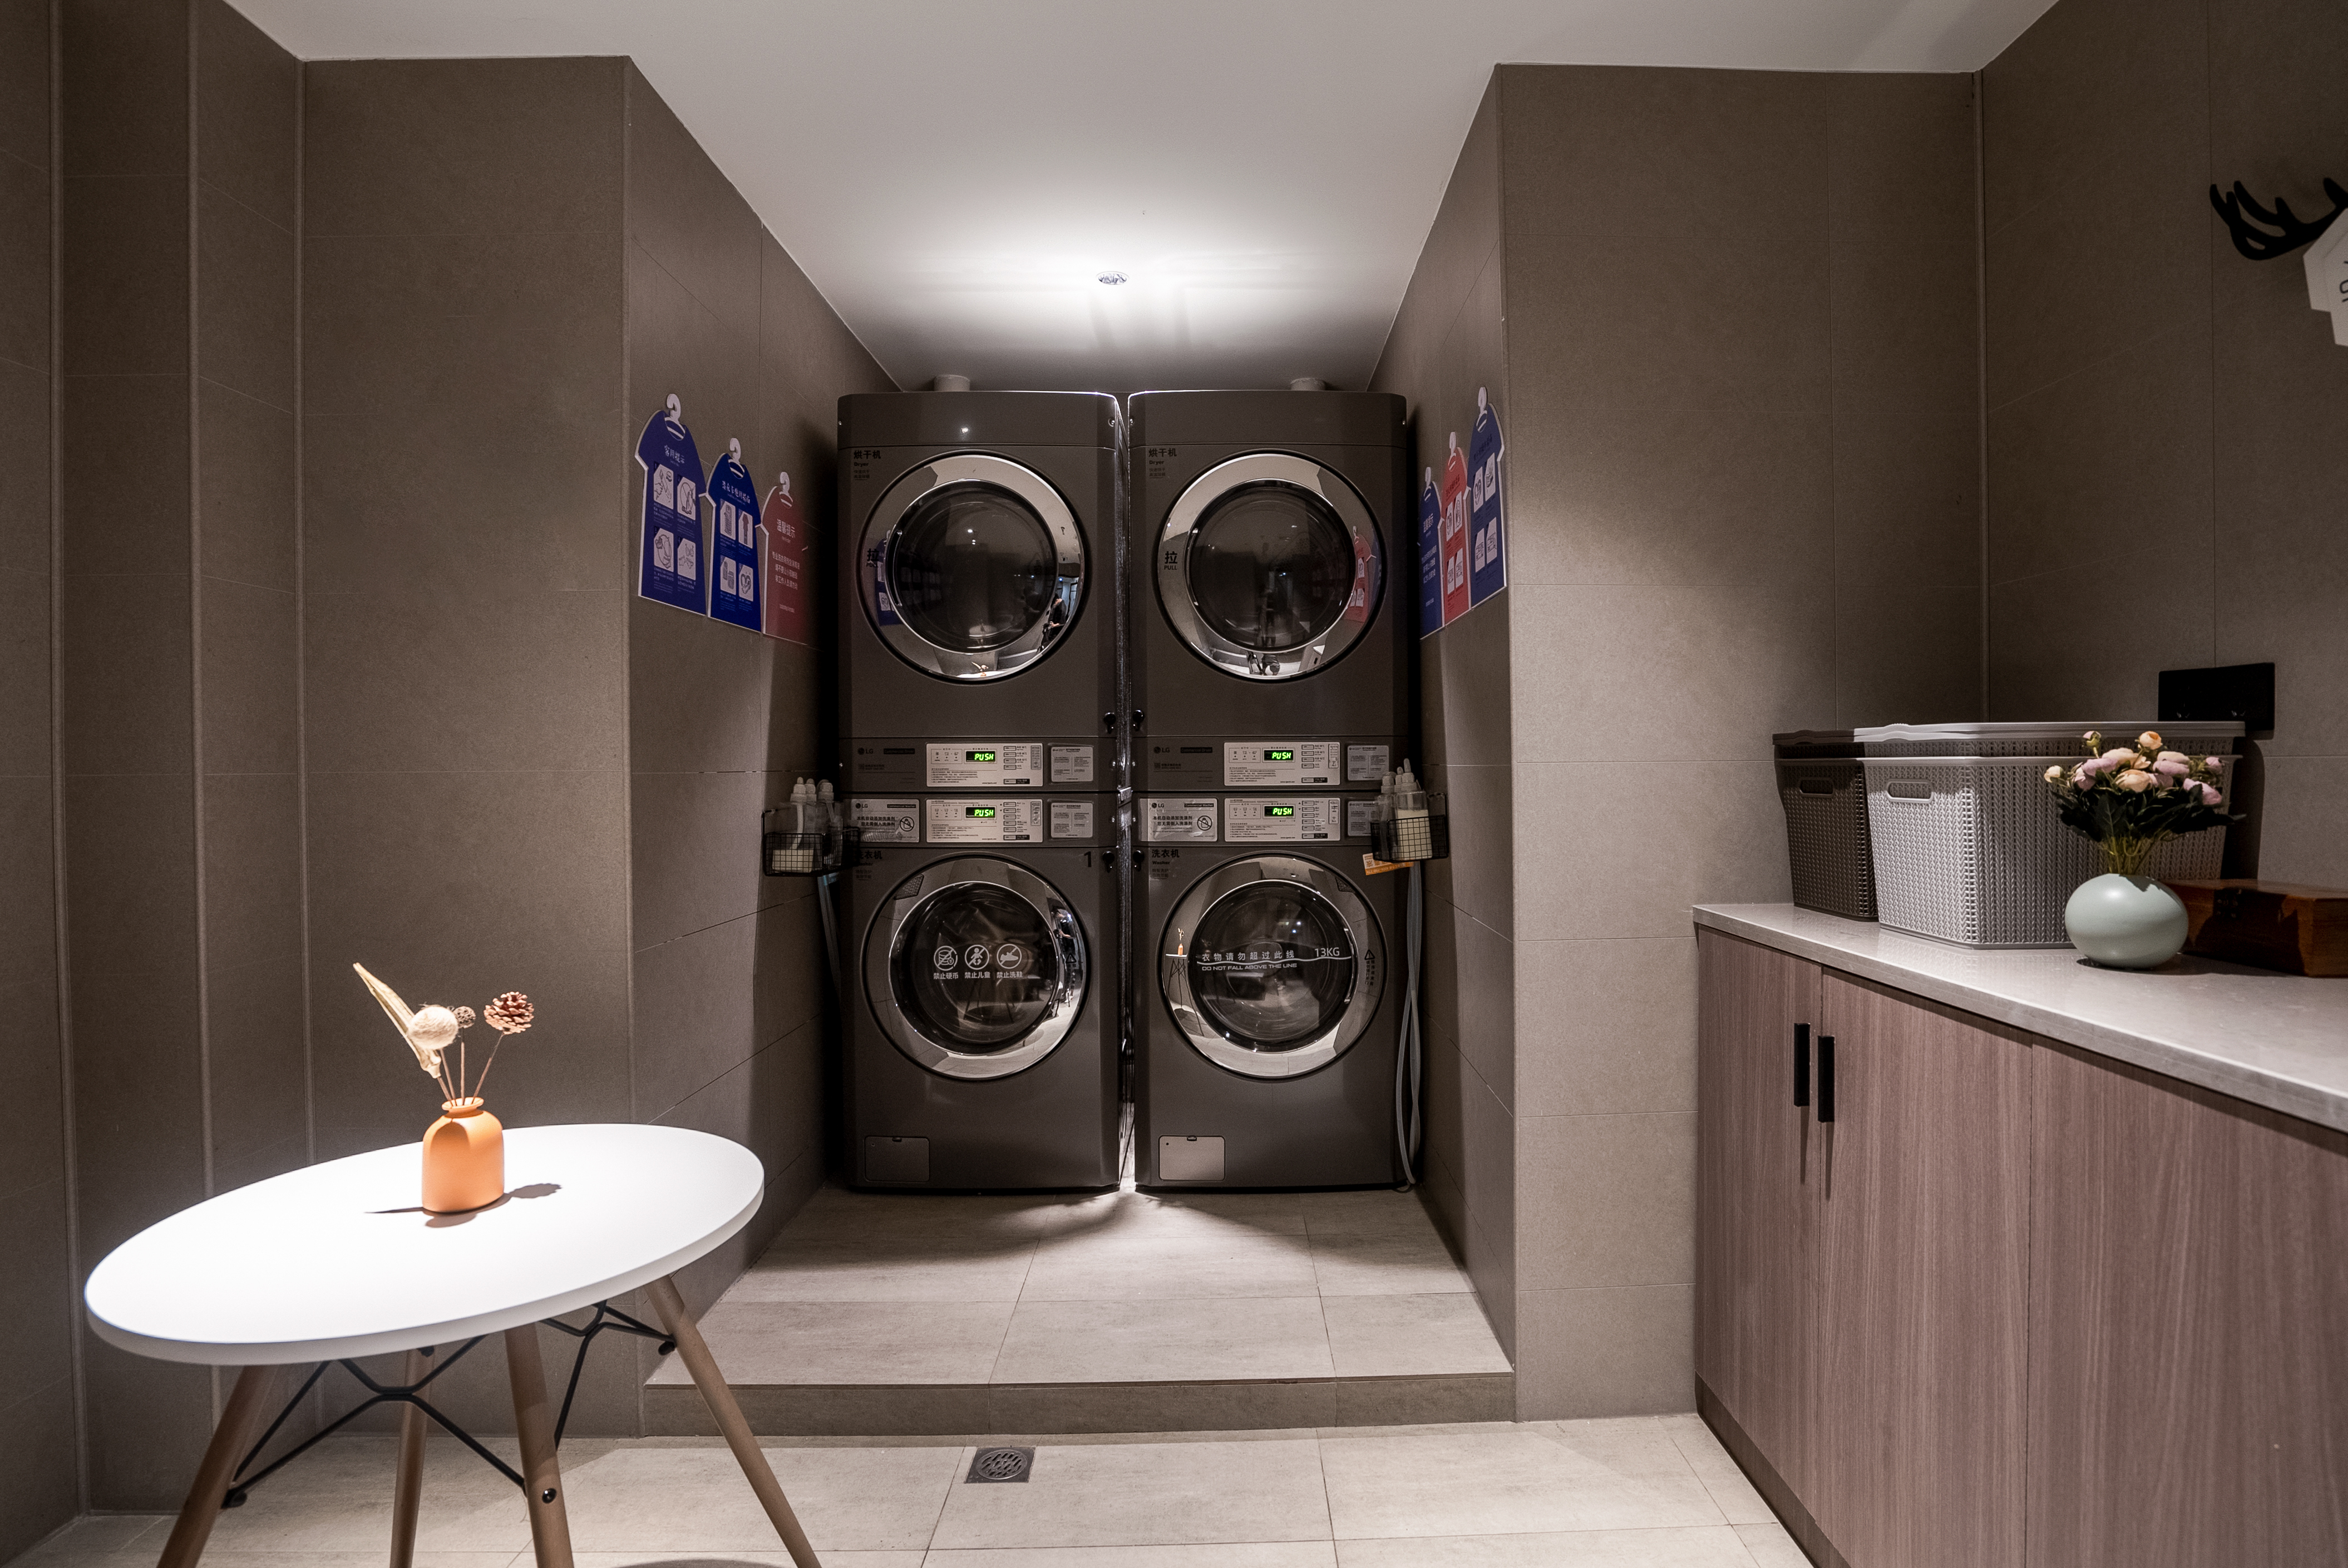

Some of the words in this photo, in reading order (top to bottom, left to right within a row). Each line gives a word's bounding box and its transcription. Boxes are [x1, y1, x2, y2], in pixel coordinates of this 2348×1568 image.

[854, 450, 881, 459] 烘干机
[1148, 448, 1177, 457] 烘干机
[777, 518, 796, 538] 温馨提示
[867, 548, 880, 561] 拉
[1165, 551, 1178, 564] 拉
[1084, 851, 1092, 868] 1
[1152, 849, 1180, 858] 洗衣机
[1202, 949, 1295, 962] 衣物请勿超过此线
[1315, 947, 1340, 957] 13KG
